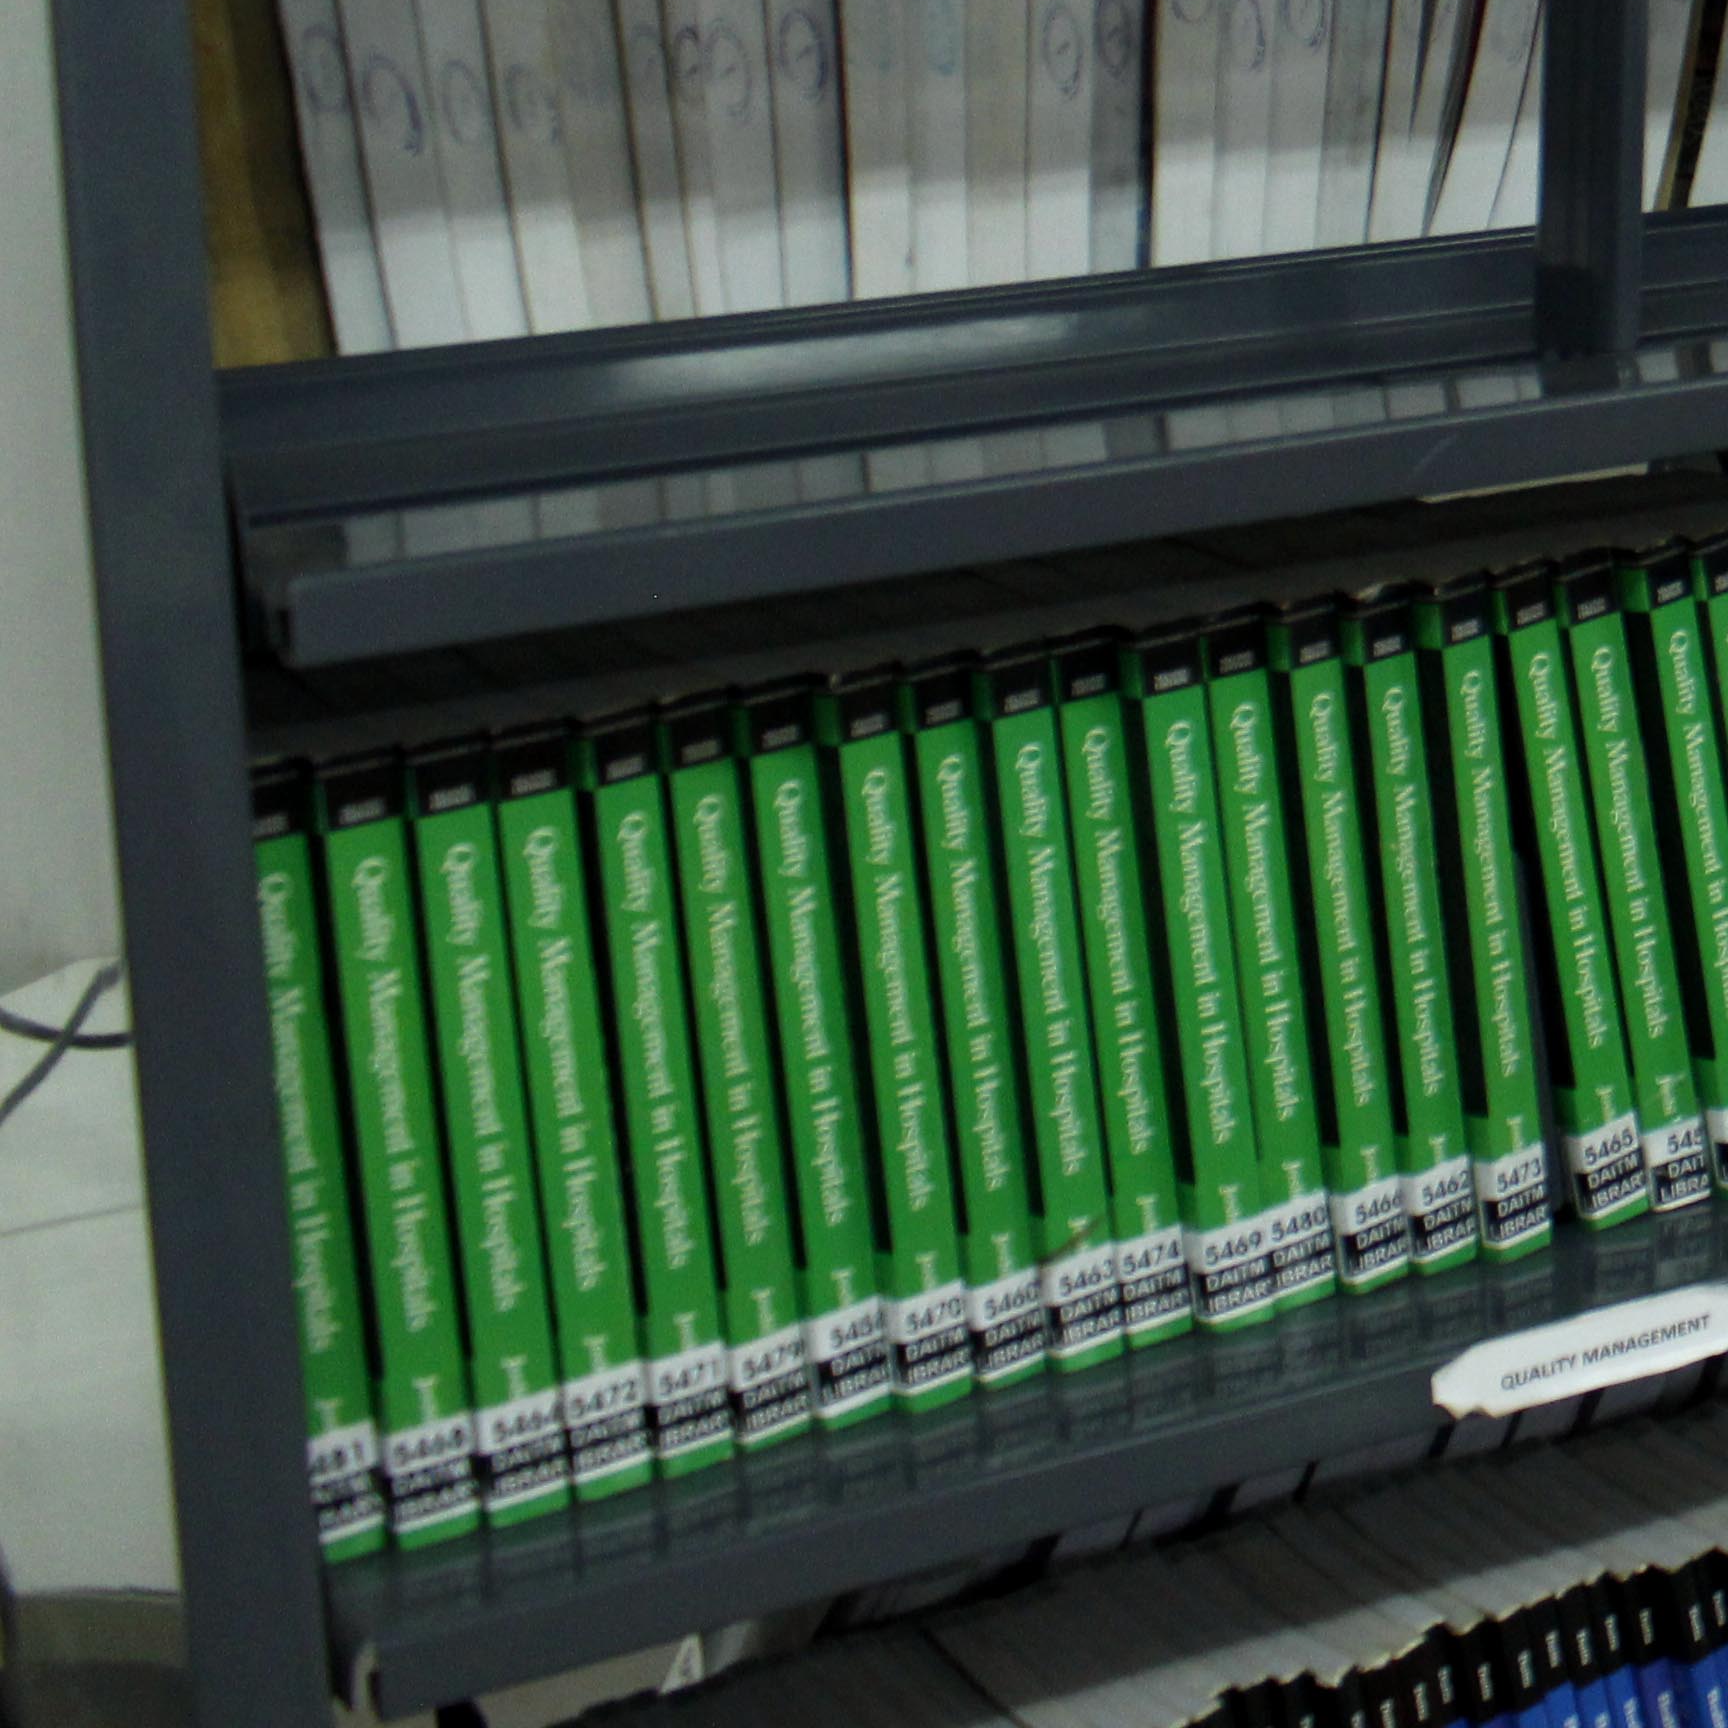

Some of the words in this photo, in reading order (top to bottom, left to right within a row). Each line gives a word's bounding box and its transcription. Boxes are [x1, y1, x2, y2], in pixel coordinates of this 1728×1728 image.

[1669, 629, 1693, 715] Quality
[1684, 724, 1722, 874] Management
[1707, 879, 1724, 904] in
[1584, 1128, 1633, 1164] 5465
[1123, 1241, 1181, 1271] 5474
[1205, 1232, 1262, 1264] 5469
[1500, 1352, 1577, 1391] QUALITY
[1581, 1314, 1711, 1364] MANAGEMENT
